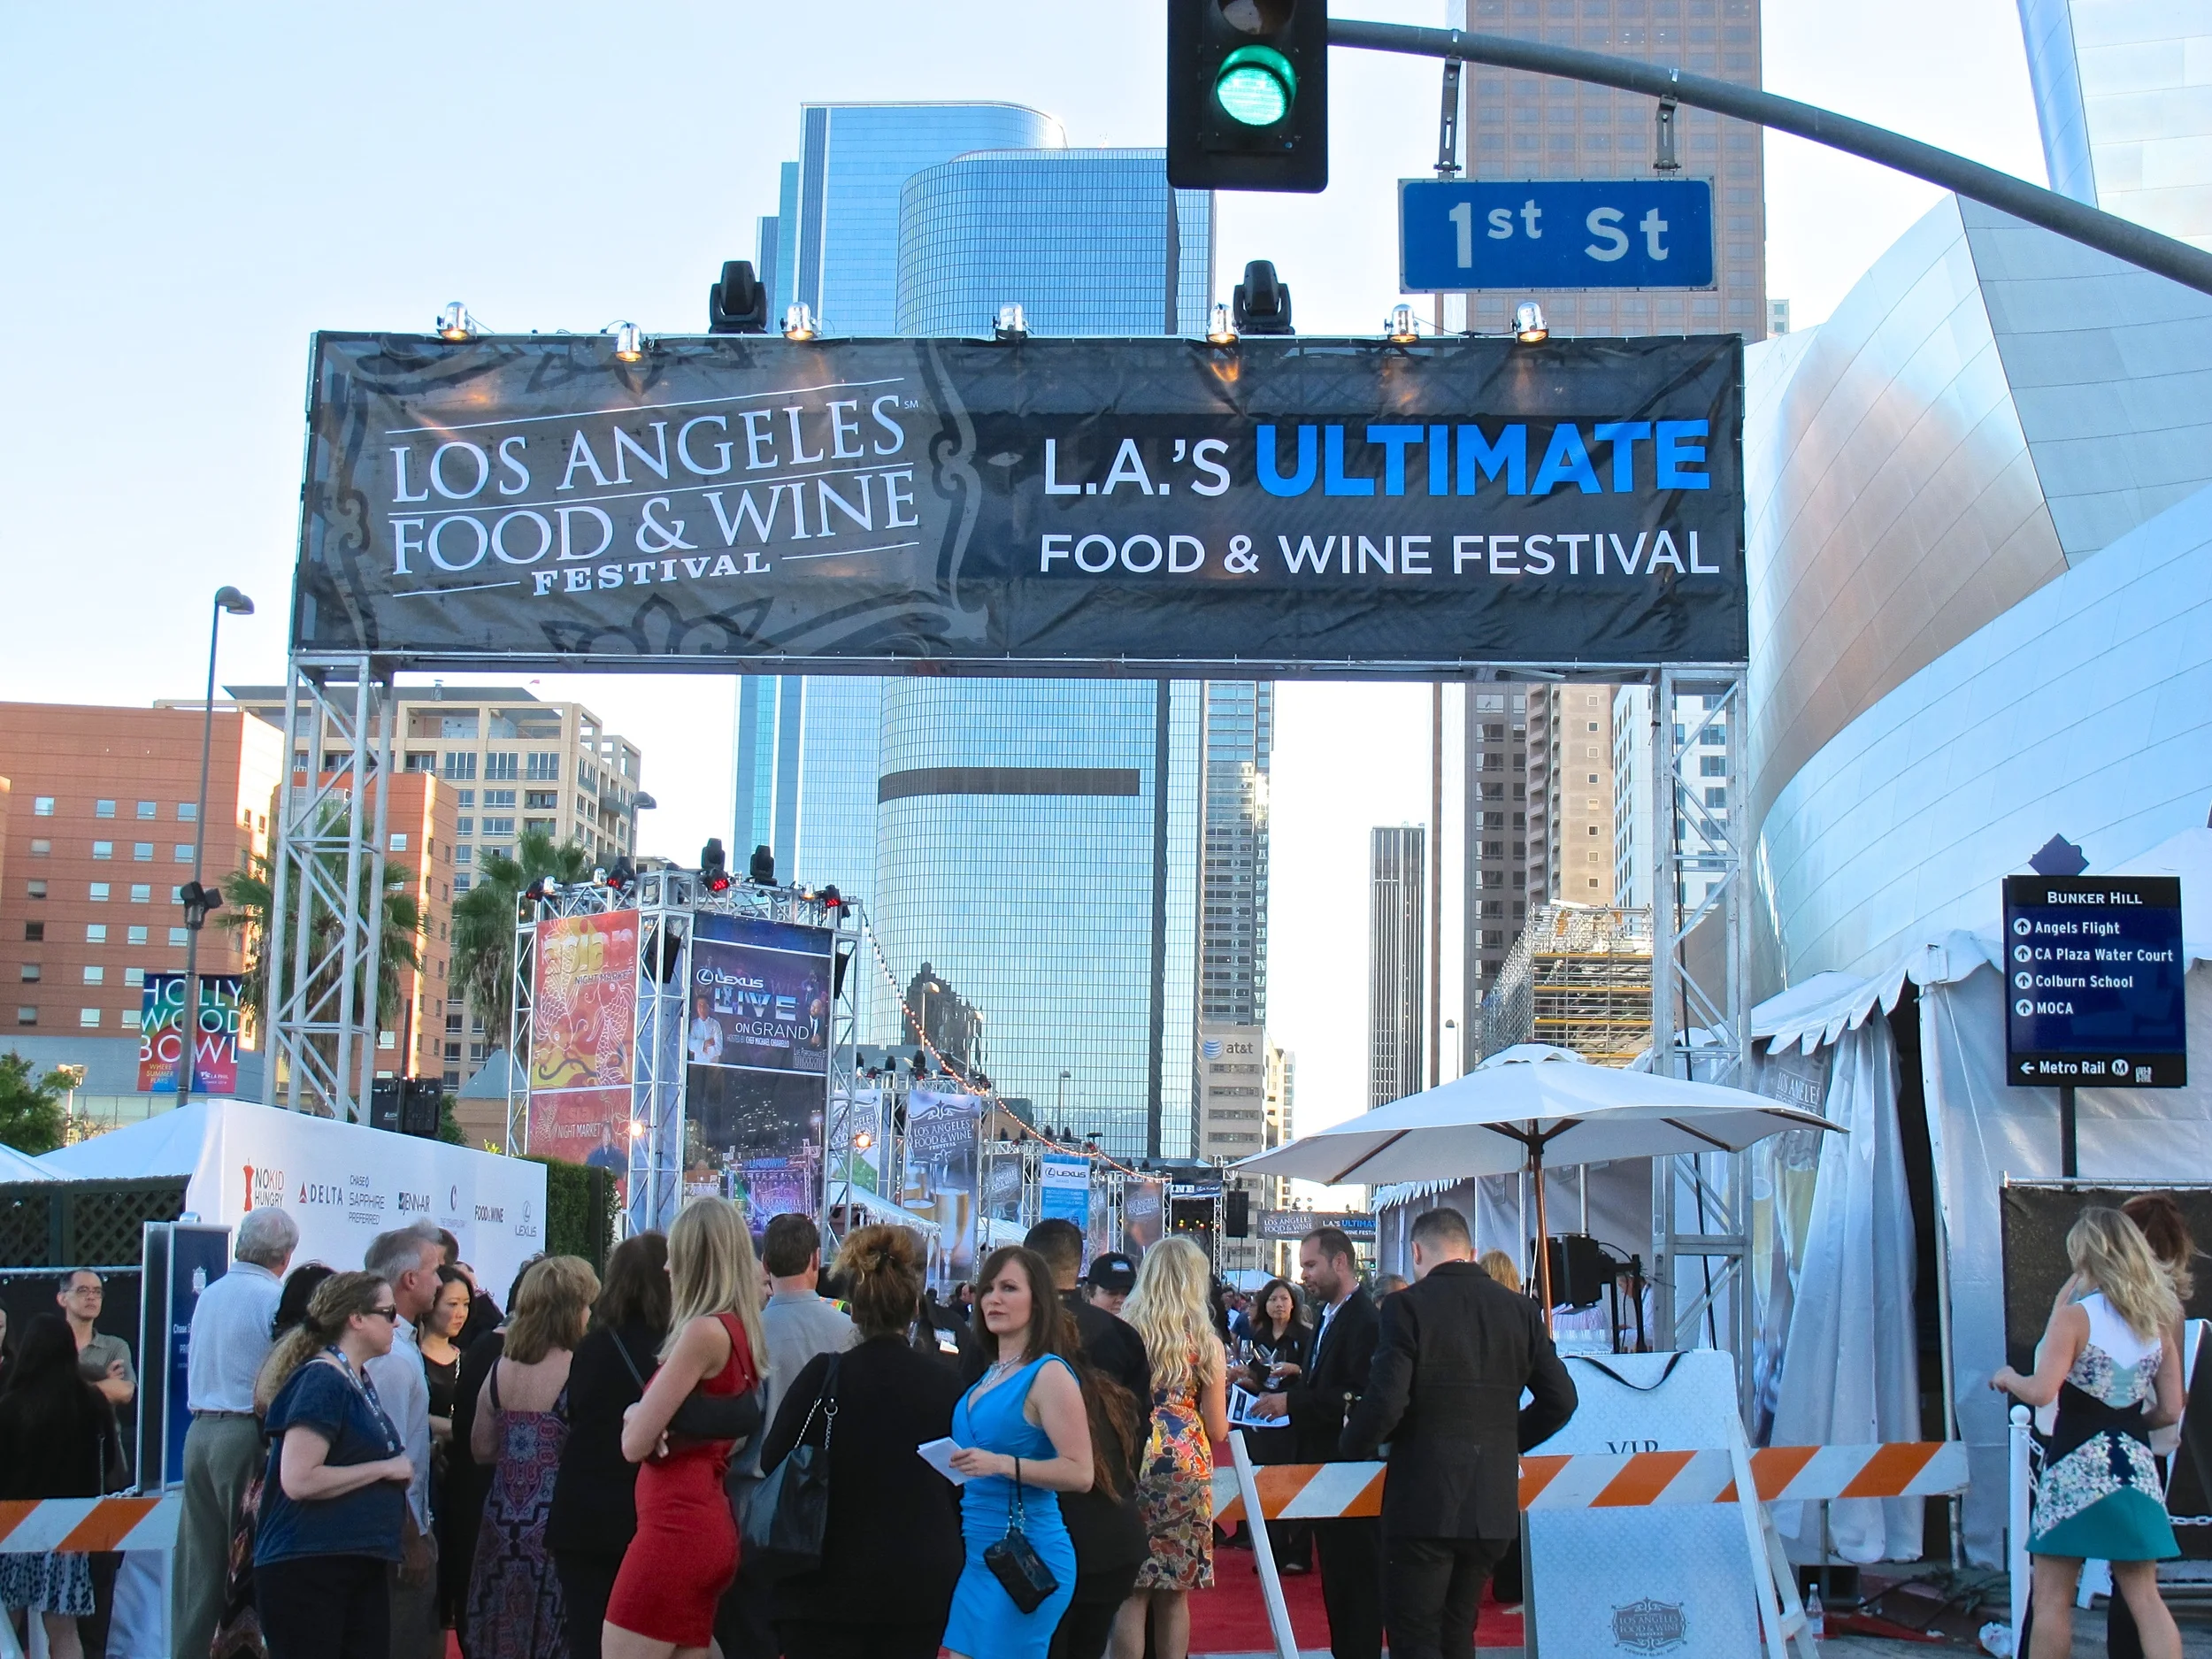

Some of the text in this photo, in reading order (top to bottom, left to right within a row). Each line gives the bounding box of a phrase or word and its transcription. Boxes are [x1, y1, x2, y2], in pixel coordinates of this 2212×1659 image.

[1448, 199, 1669, 268] 1st St
[390, 434, 531, 503] LOS
[556, 395, 904, 490] ANGELES
[1043, 419, 1711, 497] L.A.'S ULTIMATE
[391, 469, 918, 575] FOOD & WINE
[1039, 532, 1720, 575] FOOD & WINE FESTIVAL
[532, 552, 772, 596] FESTIVAL
[2035, 921, 2120, 936] Angels Flight
[2035, 948, 2173, 962] CA Plaza Water Court
[715, 974, 764, 988] LEXUS
[2035, 975, 2133, 988] Colburn School
[714, 987, 796, 1021] LIVE
[2037, 1002, 2074, 1015] MOCA
[735, 1021, 810, 1040] ON GRAND
[1226, 1042, 1254, 1054] at&t
[2039, 1061, 2078, 1074] Metro
[2082, 1061, 2105, 1074] Rail
[913, 1118, 971, 1137] LOS ANGELES
[914, 1130, 972, 1148] FOOD & WINE
[1056, 1170, 1087, 1179] LEXUS
[255, 1190, 284, 1208] HUNGRY
[310, 1184, 343, 1205] DELTA
[349, 1192, 385, 1210] SAPPHIRE
[349, 1211, 380, 1225] PREFERRED
[1279, 1216, 1312, 1225] ANGELES
[515, 1225, 537, 1237] LEXUS
[1639, 1615, 1678, 1624] ANGELES
